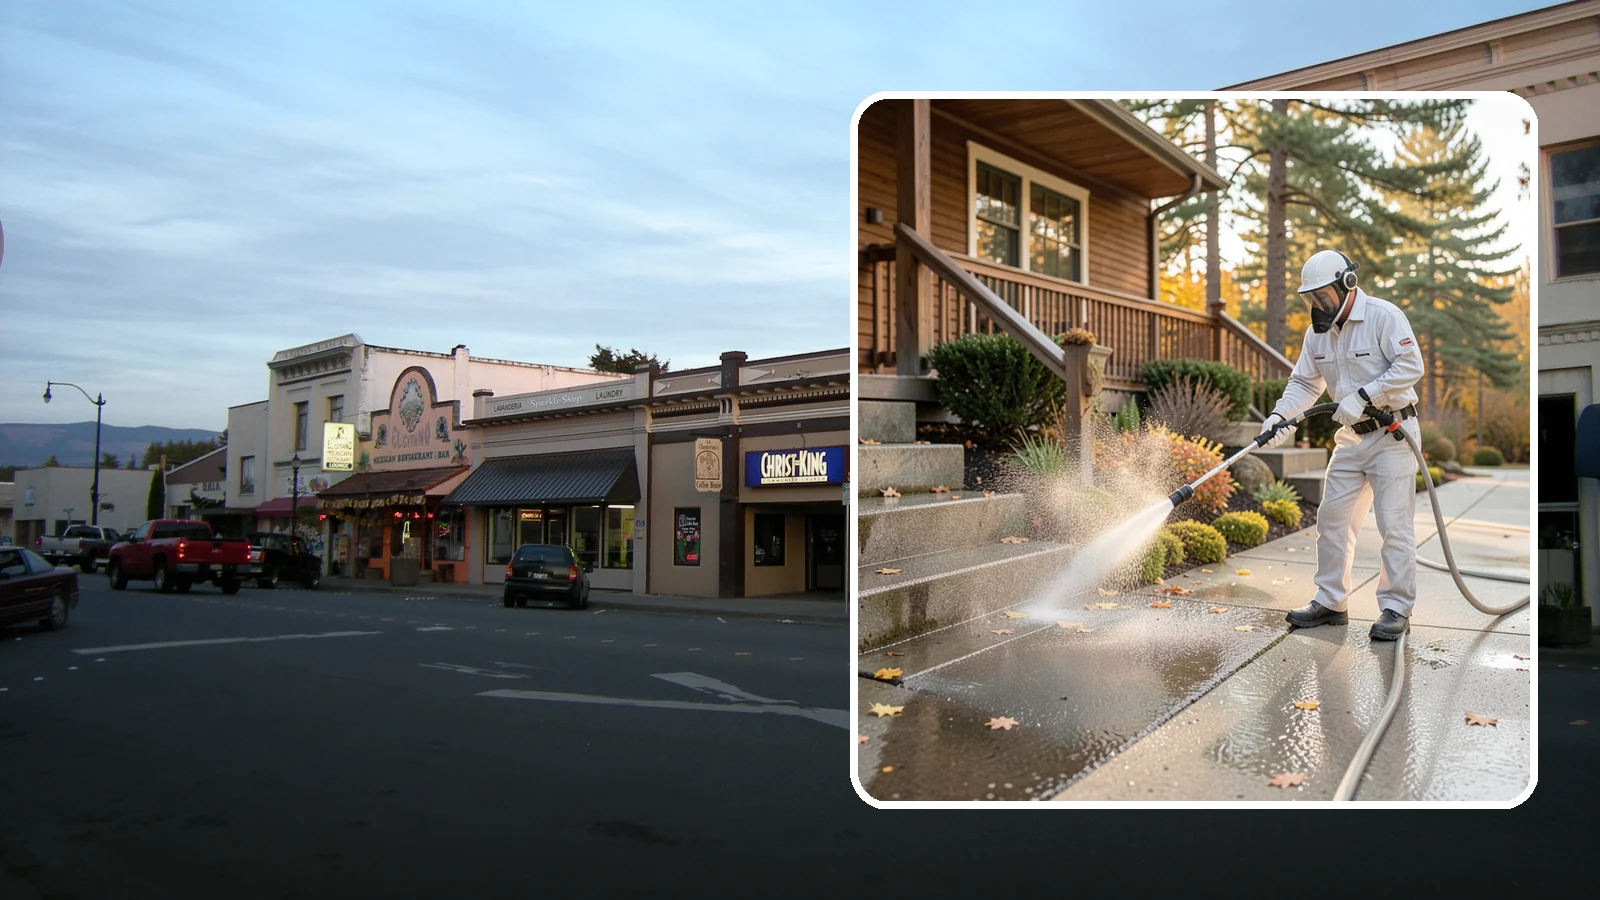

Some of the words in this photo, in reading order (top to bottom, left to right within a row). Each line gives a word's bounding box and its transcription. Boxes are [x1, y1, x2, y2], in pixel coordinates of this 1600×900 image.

[493, 402, 523, 413] LAVANDERIA
[562, 394, 582, 404] Shop
[596, 388, 624, 400] LAUNDRY
[373, 455, 396, 464] MEXICAN
[397, 452, 433, 462] RESTAURANT
[438, 450, 450, 458] BAR
[761, 452, 797, 477] CHRIST
[799, 450, 827, 476] KING
